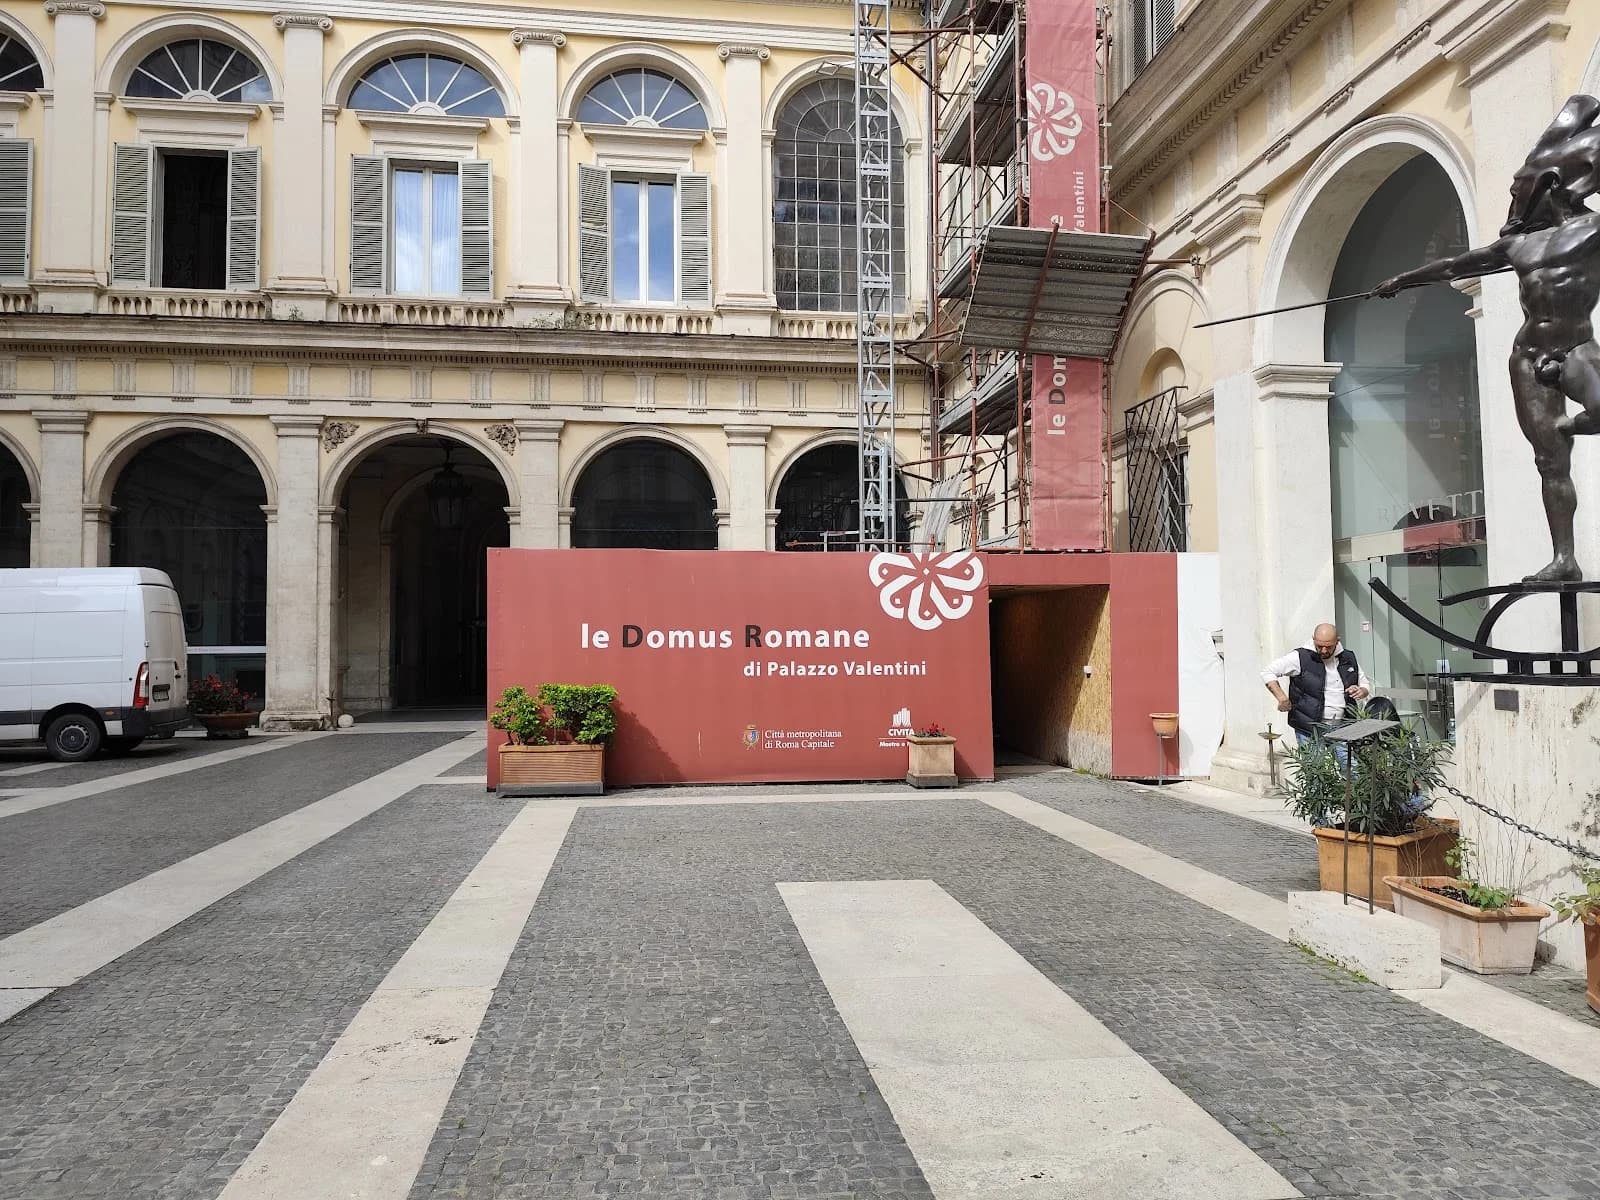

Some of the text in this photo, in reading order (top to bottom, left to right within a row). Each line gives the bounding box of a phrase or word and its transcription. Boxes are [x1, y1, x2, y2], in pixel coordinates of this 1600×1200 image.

[1047, 414, 1066, 436] le
[580, 623, 870, 649] le Domus Romane
[743, 660, 927, 677] di Palazzo Valentini
[764, 729, 842, 740] Città metropolitana
[887, 728, 915, 736] CIVITA
[764, 740, 835, 750] di Roma Capitale
